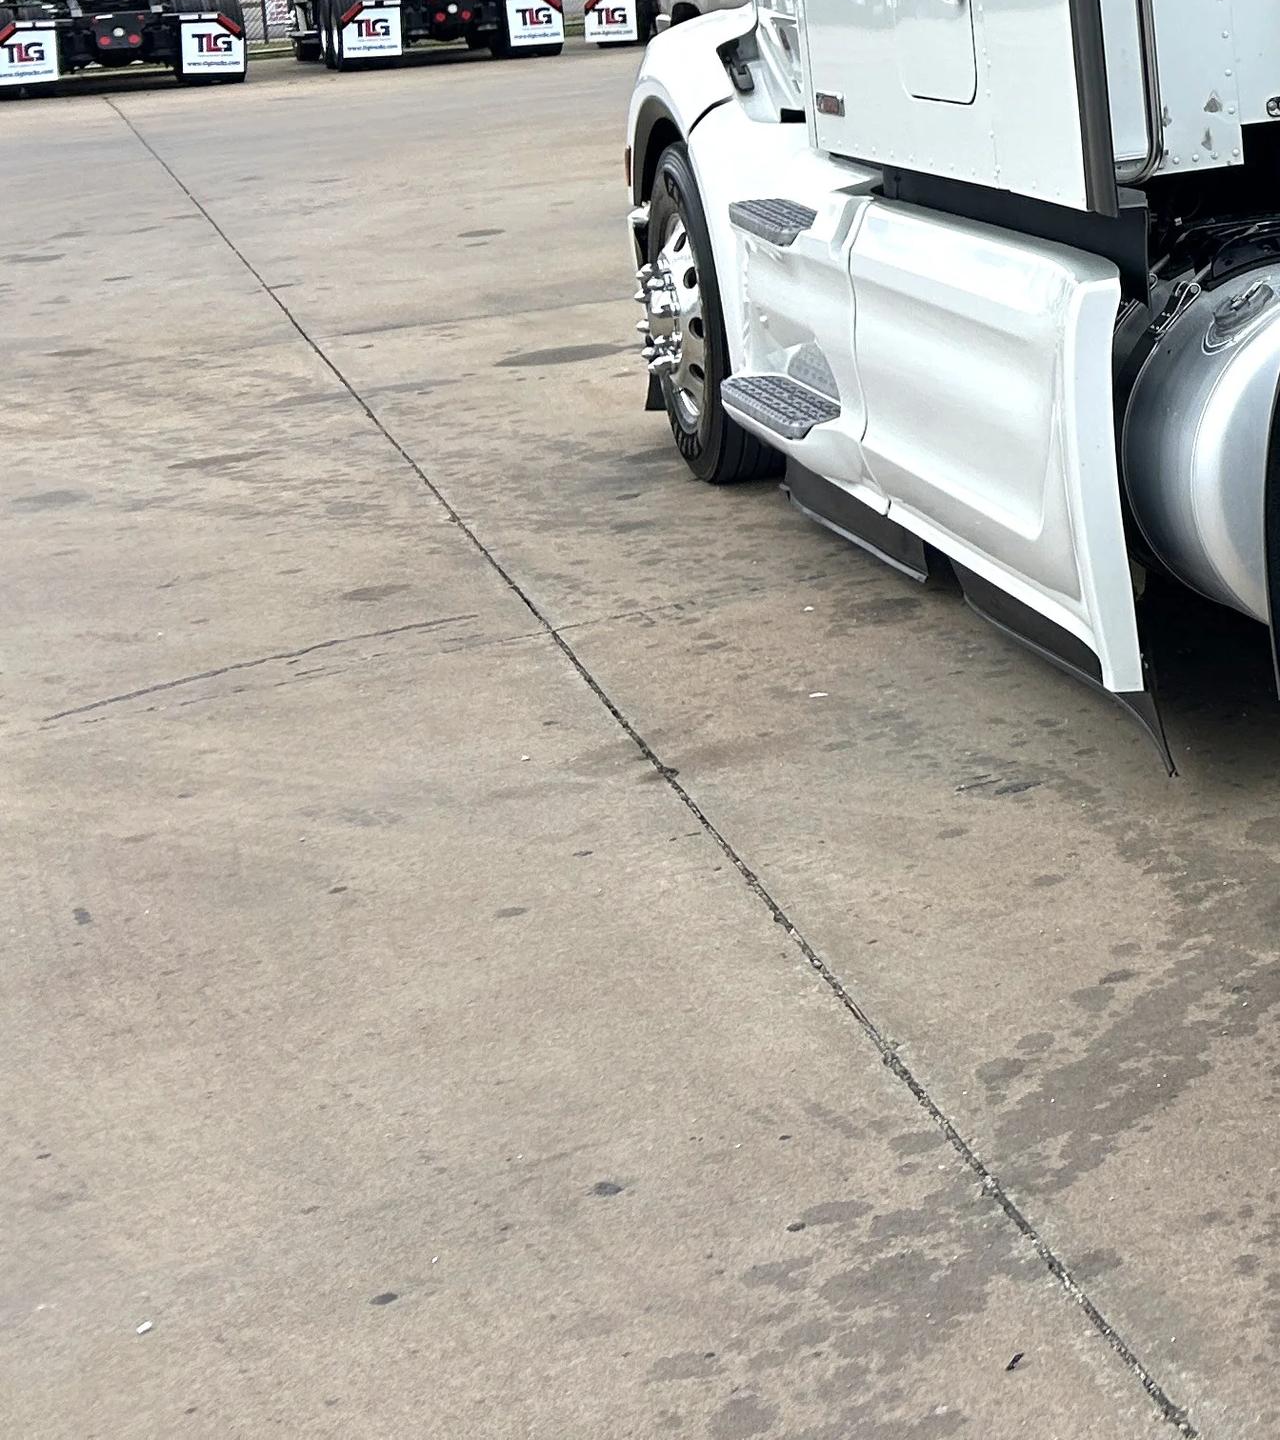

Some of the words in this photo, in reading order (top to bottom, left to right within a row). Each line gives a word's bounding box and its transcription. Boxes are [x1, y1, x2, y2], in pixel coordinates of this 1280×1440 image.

[515, 7, 552, 26] TLG
[592, 7, 627, 25] TLG
[352, 19, 390, 37] TLG
[191, 33, 232, 52] TLG
[1, 42, 45, 63] TLG
